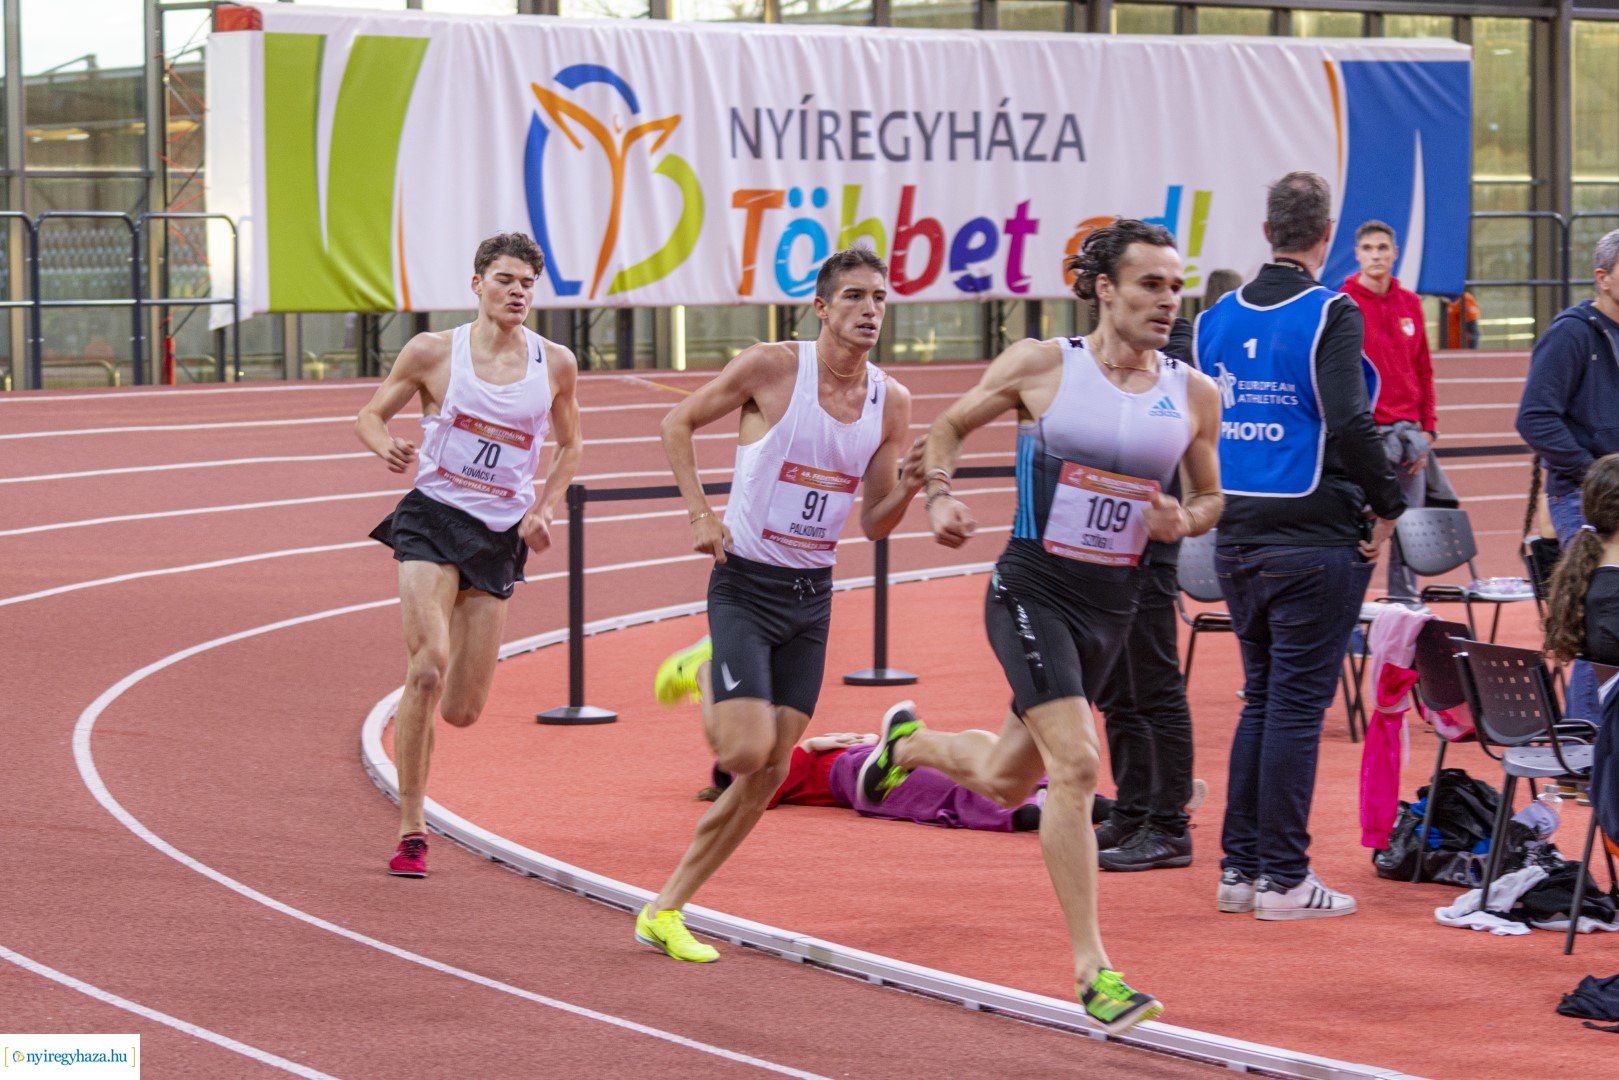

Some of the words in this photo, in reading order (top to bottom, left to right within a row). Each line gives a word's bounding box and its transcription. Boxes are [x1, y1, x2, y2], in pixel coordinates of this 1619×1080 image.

[730, 94, 1087, 163] NYÍREGYHÁZA
[1243, 338, 1259, 359] 1
[1238, 380, 1296, 392] EUROPEAN
[1237, 393, 1300, 406] ATHLETICS
[472, 438, 502, 469] 70
[461, 465, 489, 481] KOVÁCS
[801, 490, 829, 522] 91
[1086, 495, 1132, 533] 109
[789, 522, 827, 539] PALKOVITS
